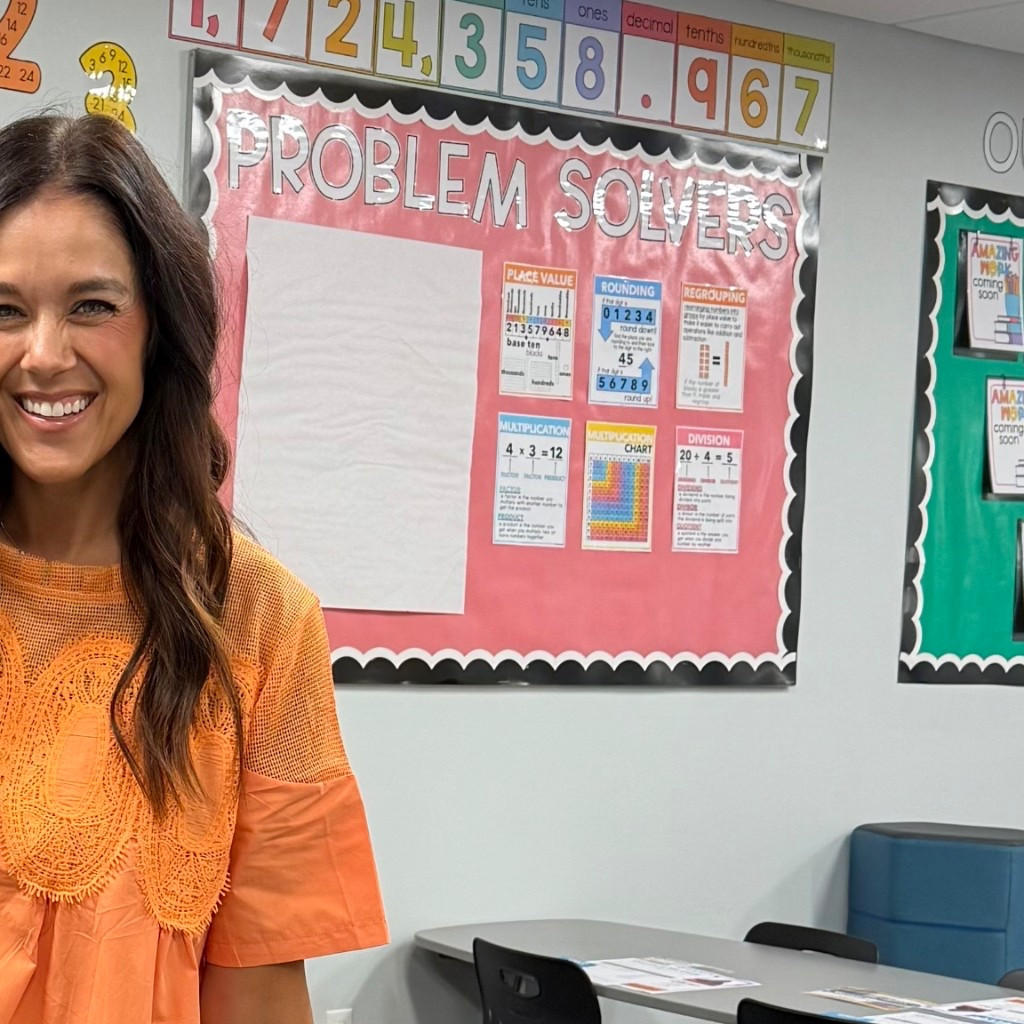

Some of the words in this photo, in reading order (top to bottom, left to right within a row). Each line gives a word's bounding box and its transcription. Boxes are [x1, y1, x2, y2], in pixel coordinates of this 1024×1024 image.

[16, 2, 27, 15] 12
[577, 4, 609, 22] ones
[6, 19, 17, 32] 14
[324, 0, 361, 58] 2
[625, 13, 674, 35] decimal
[685, 24, 725, 45] tenths
[454, 12, 487, 79] 3
[99, 52, 107, 64] 6
[109, 49, 116, 61] 9
[516, 22, 547, 90] 5
[89, 59, 96, 71] 3
[118, 60, 128, 74] 12
[575, 36, 606, 100] 8
[19, 69, 34, 82] 24
[93, 97, 105, 110] 21
[740, 68, 770, 128] 6
[794, 75, 820, 136] 7
[225, 107, 528, 231] PROBLEM
[553, 157, 794, 261] SOLVERS
[506, 268, 539, 284] PLACE
[540, 273, 574, 287] VALUE
[972, 277, 1004, 293] coming
[601, 281, 656, 298] ROUNDING
[683, 286, 746, 304] REGROUPING
[978, 290, 999, 301] soon
[603, 307, 610, 319] 0
[614, 308, 619, 320] 1
[624, 309, 631, 321] 2
[635, 310, 642, 322] 3
[645, 311, 653, 323] 4
[506, 337, 525, 348] base
[527, 340, 541, 349] ten
[618, 352, 634, 365] 45
[598, 376, 605, 388] 5
[609, 377, 616, 389] 6
[620, 378, 627, 390] 7
[631, 379, 637, 391] 8
[641, 379, 648, 391] 9
[499, 419, 569, 437] MULTIPLICATION
[993, 424, 1024, 437] coming
[687, 432, 731, 447] DIVISION
[999, 435, 1020, 446] soon
[506, 442, 513, 456] 4
[528, 444, 536, 457] 3
[549, 446, 563, 460] 12
[624, 443, 653, 454] CHART
[679, 449, 692, 461] 20
[703, 451, 711, 462] 4
[726, 452, 733, 463] 5
